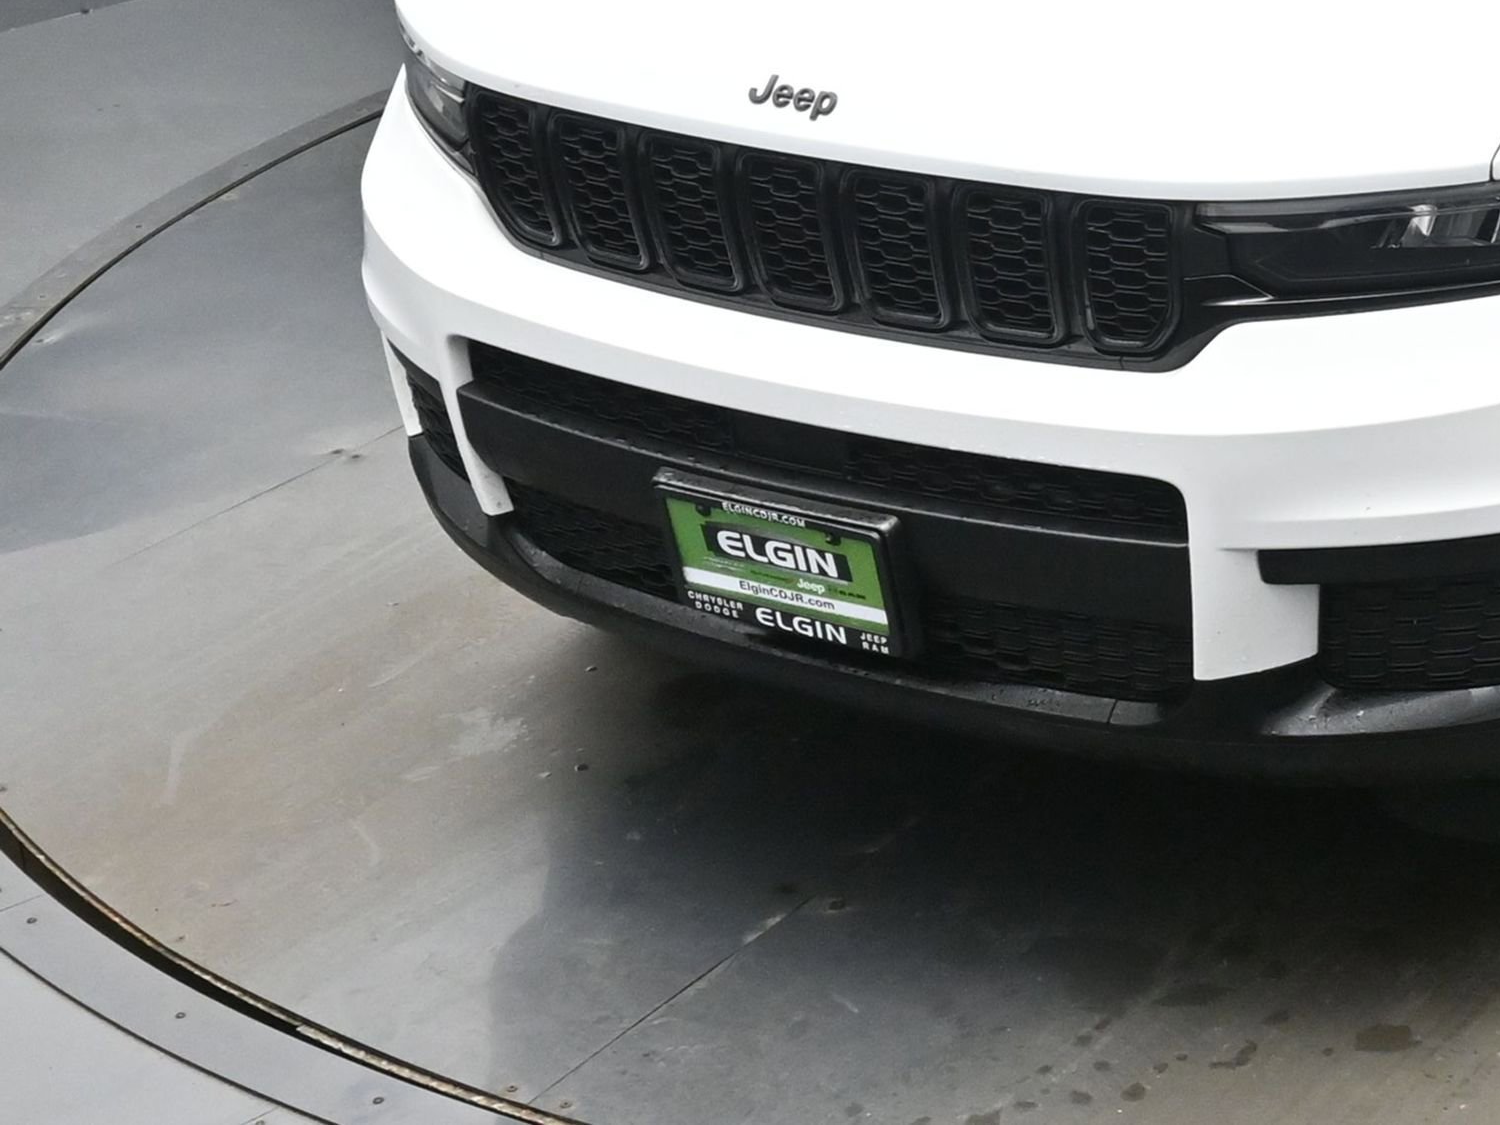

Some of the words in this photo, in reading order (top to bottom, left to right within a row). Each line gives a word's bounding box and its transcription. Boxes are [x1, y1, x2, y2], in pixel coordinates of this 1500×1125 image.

[748, 73, 839, 122] Jeep
[722, 501, 806, 528] ELGINCDJR.COM
[717, 530, 839, 579] ELGIN
[739, 579, 836, 611] ElginCDJR.com
[797, 578, 826, 595] Jeep
[688, 590, 744, 611] CHRYSLER
[695, 601, 739, 619] DODGE
[755, 607, 848, 645] ELGIN
[860, 631, 888, 645] JEEP
